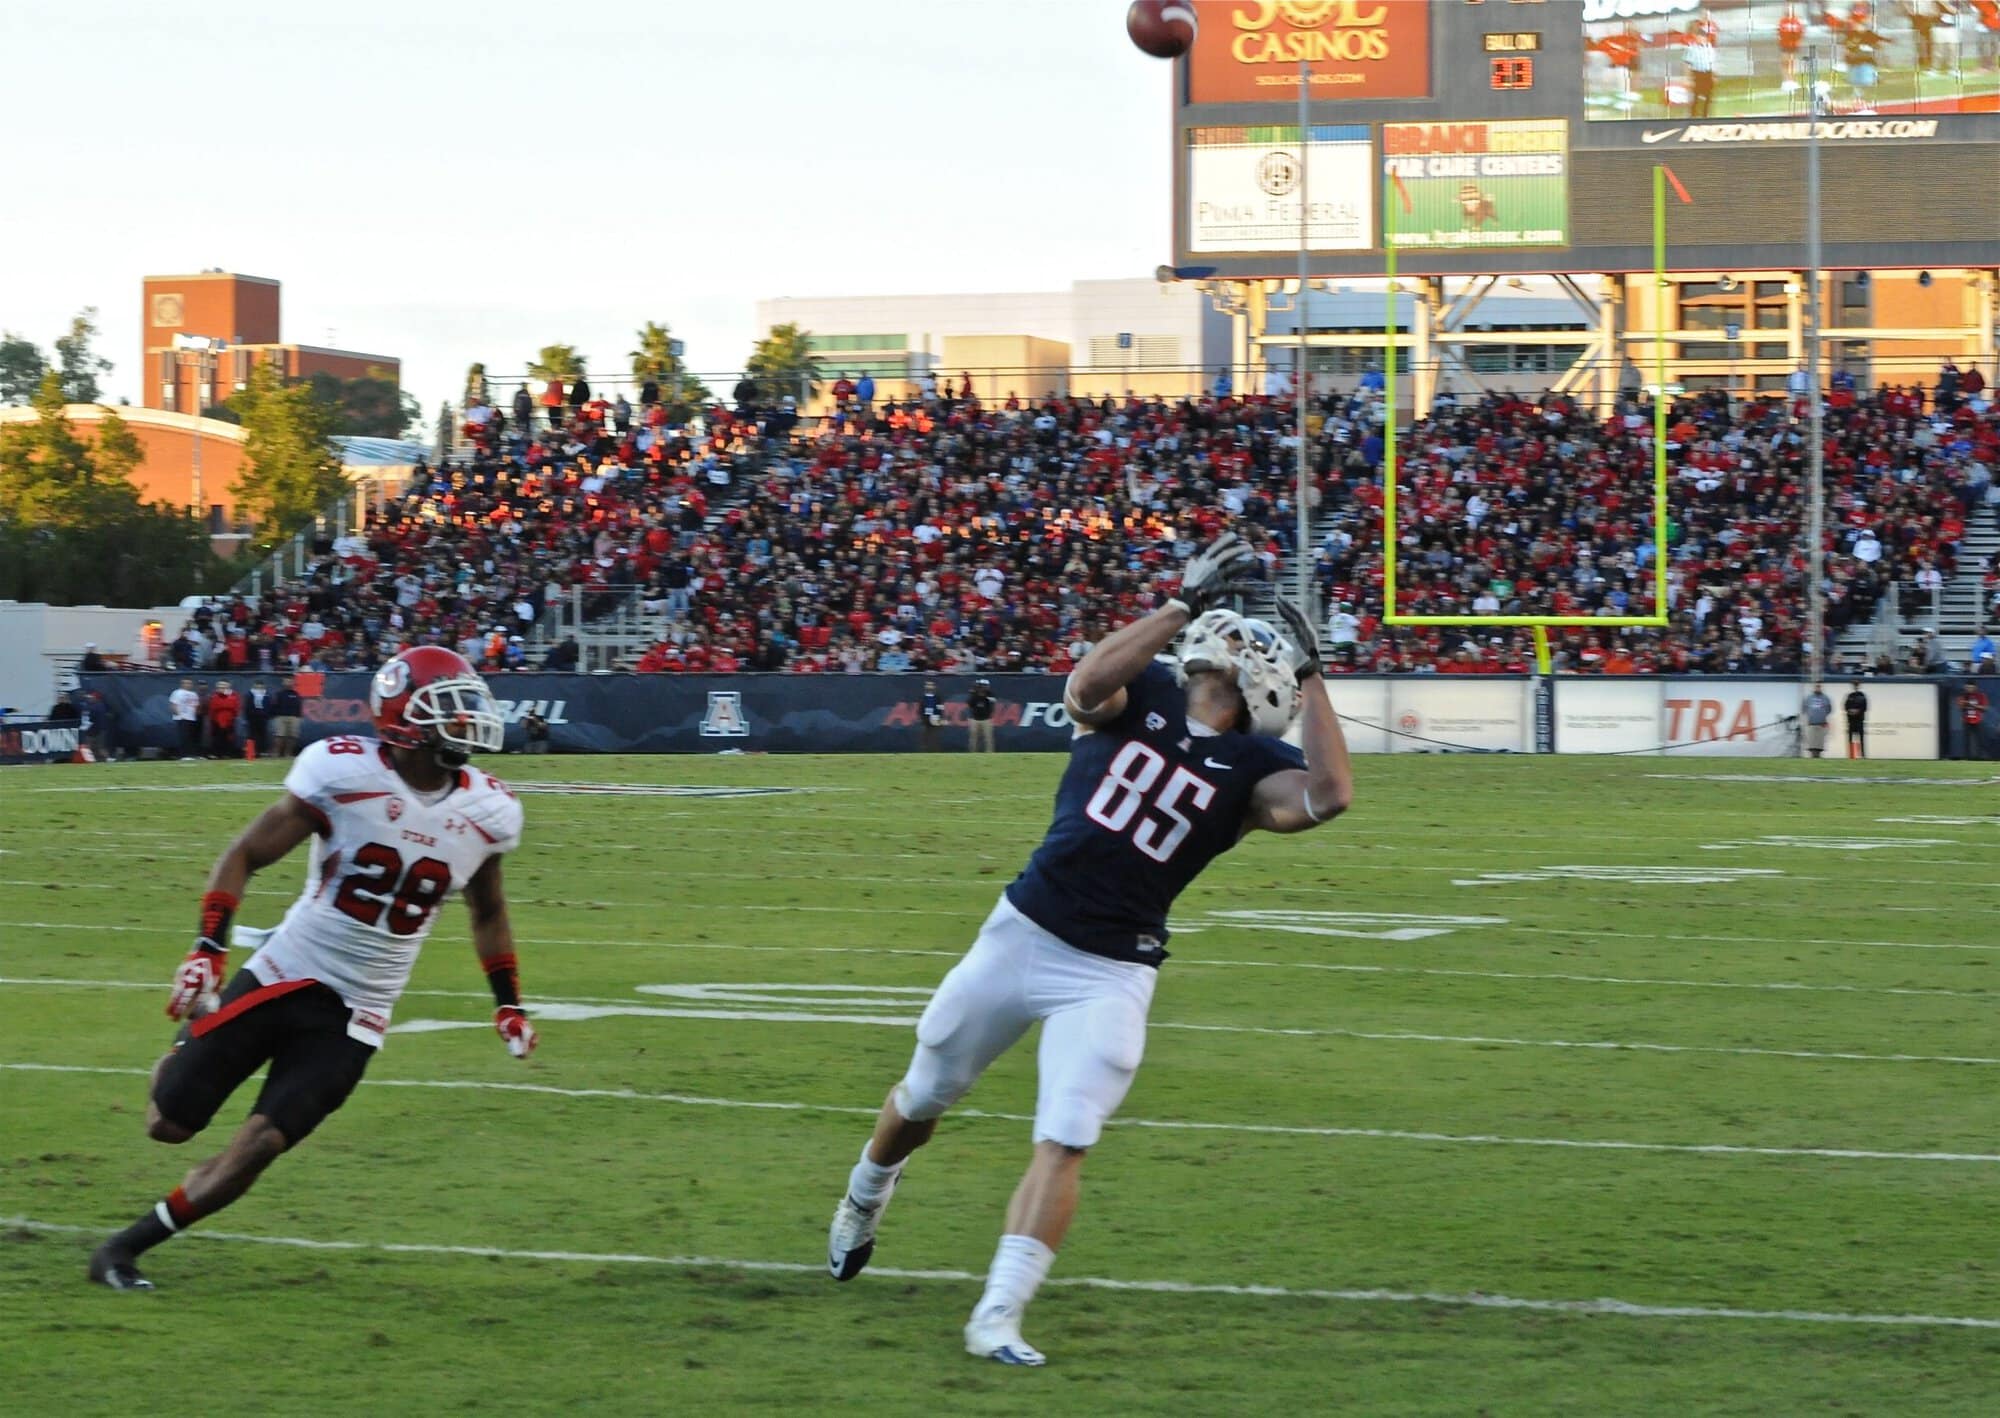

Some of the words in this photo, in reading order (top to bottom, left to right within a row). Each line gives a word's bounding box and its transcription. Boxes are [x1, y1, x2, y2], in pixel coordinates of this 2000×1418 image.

[1231, 29, 1390, 64] CASINOS
[1490, 57, 1533, 89] 23
[1664, 699, 1757, 742] TRA
[1086, 740, 1217, 863] 85
[334, 841, 452, 936] 28
